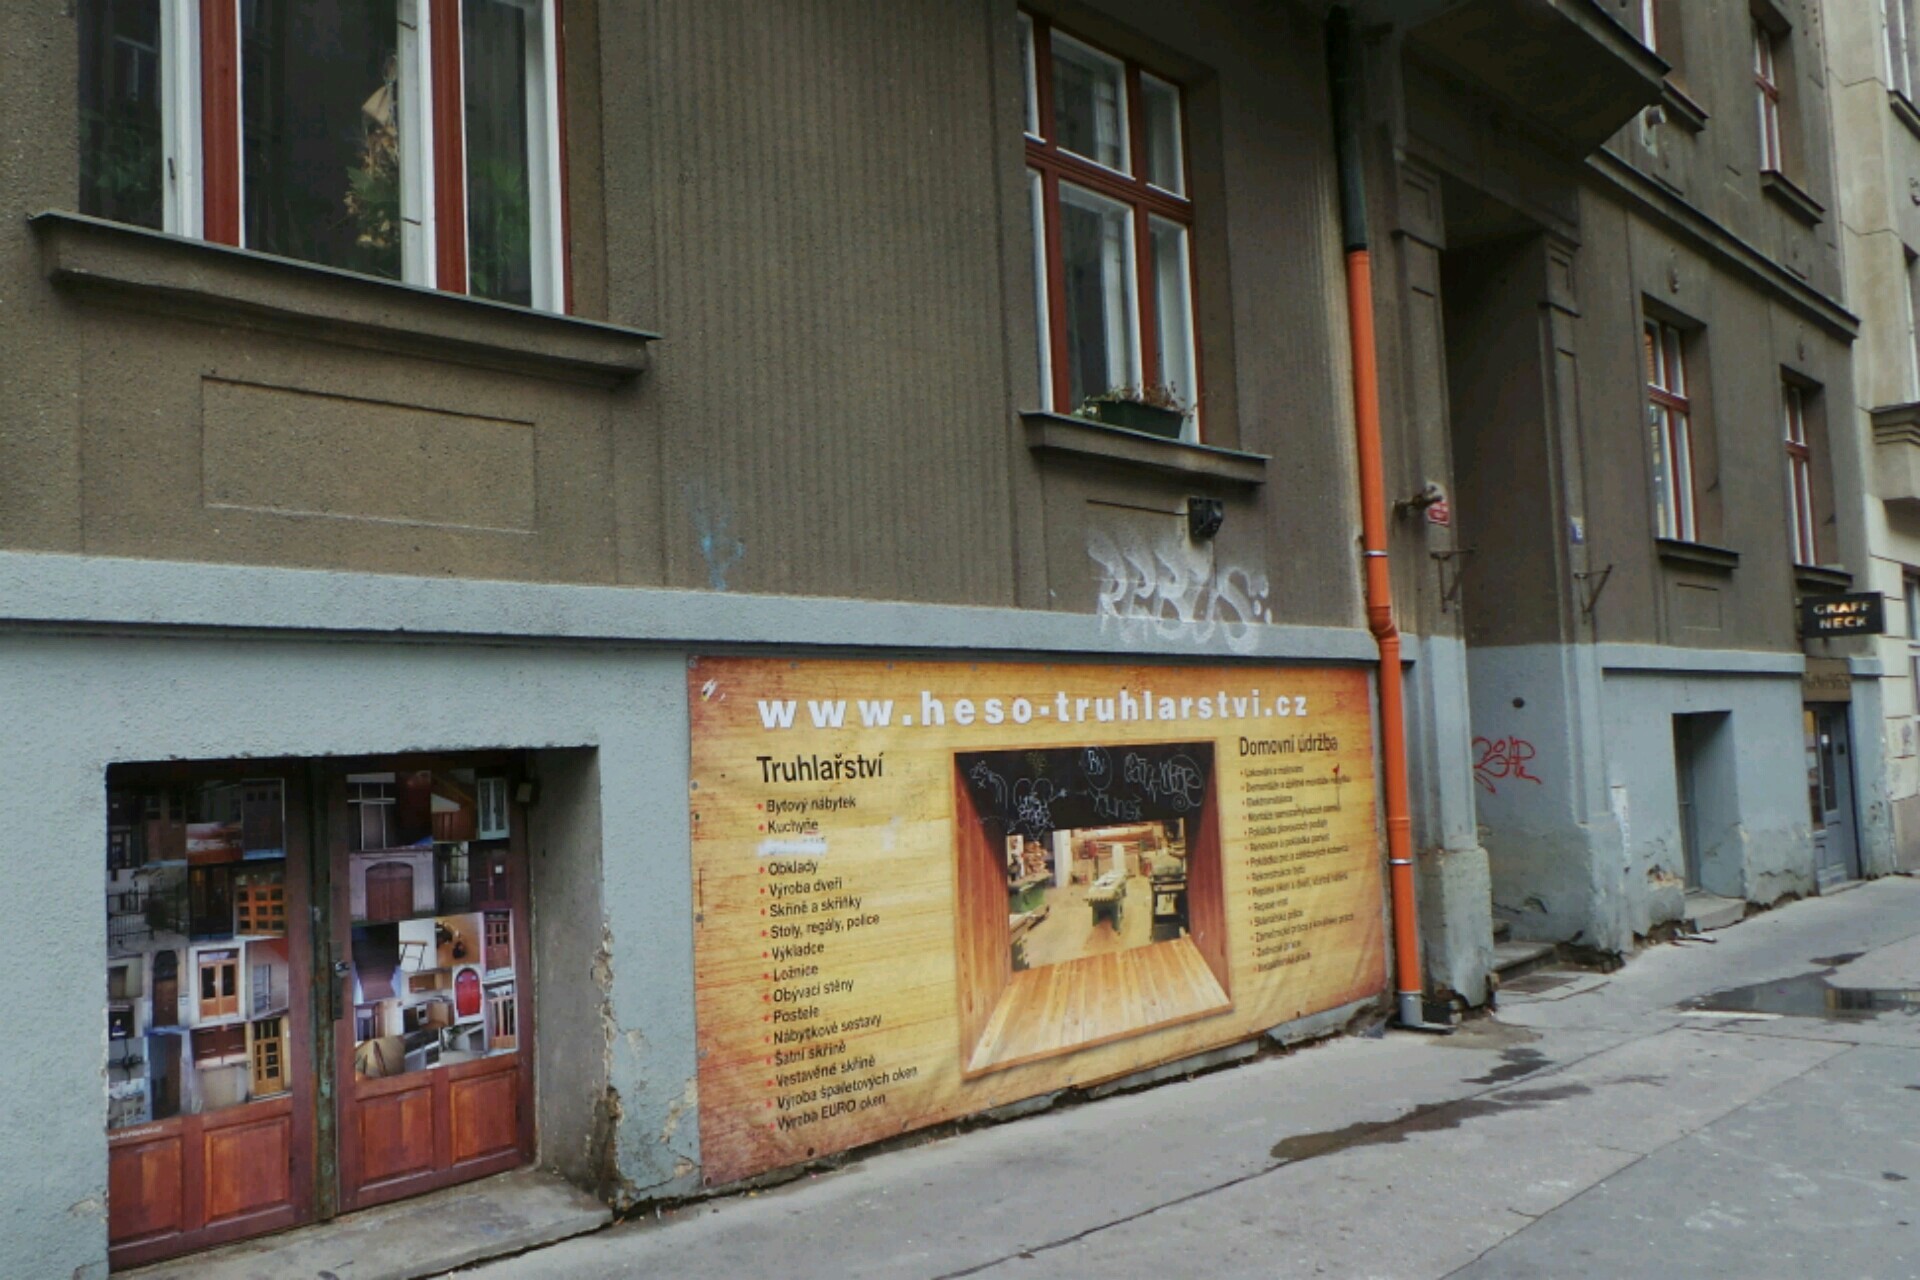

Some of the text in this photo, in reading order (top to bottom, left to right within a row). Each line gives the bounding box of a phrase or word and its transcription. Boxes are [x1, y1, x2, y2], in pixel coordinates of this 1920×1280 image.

[1819, 615, 1868, 629] NECK
[757, 690, 1308, 729] www.heso-truhlarstvi.cz
[1298, 732, 1338, 753] údržba
[756, 752, 884, 783] Truhlařství
[766, 796, 857, 816] Bytový nábytek
[768, 860, 818, 876] Obklady
[768, 881, 811, 899] Výroba
[811, 903, 819, 914] a
[770, 912, 880, 940] Stoly, regály, police
[771, 942, 825, 962] Výkladce
[773, 964, 819, 982] Ložnice
[773, 979, 854, 1003] Obývací stěny
[773, 1005, 820, 1024] Postele
[773, 1022, 839, 1046] Nábytkové
[774, 1039, 846, 1067] Šatní skříně
[775, 1064, 837, 1088] Vestavěné
[776, 1065, 919, 1112] Výroba špaletových oken
[776, 1093, 886, 1134] Výroba EURO oken
